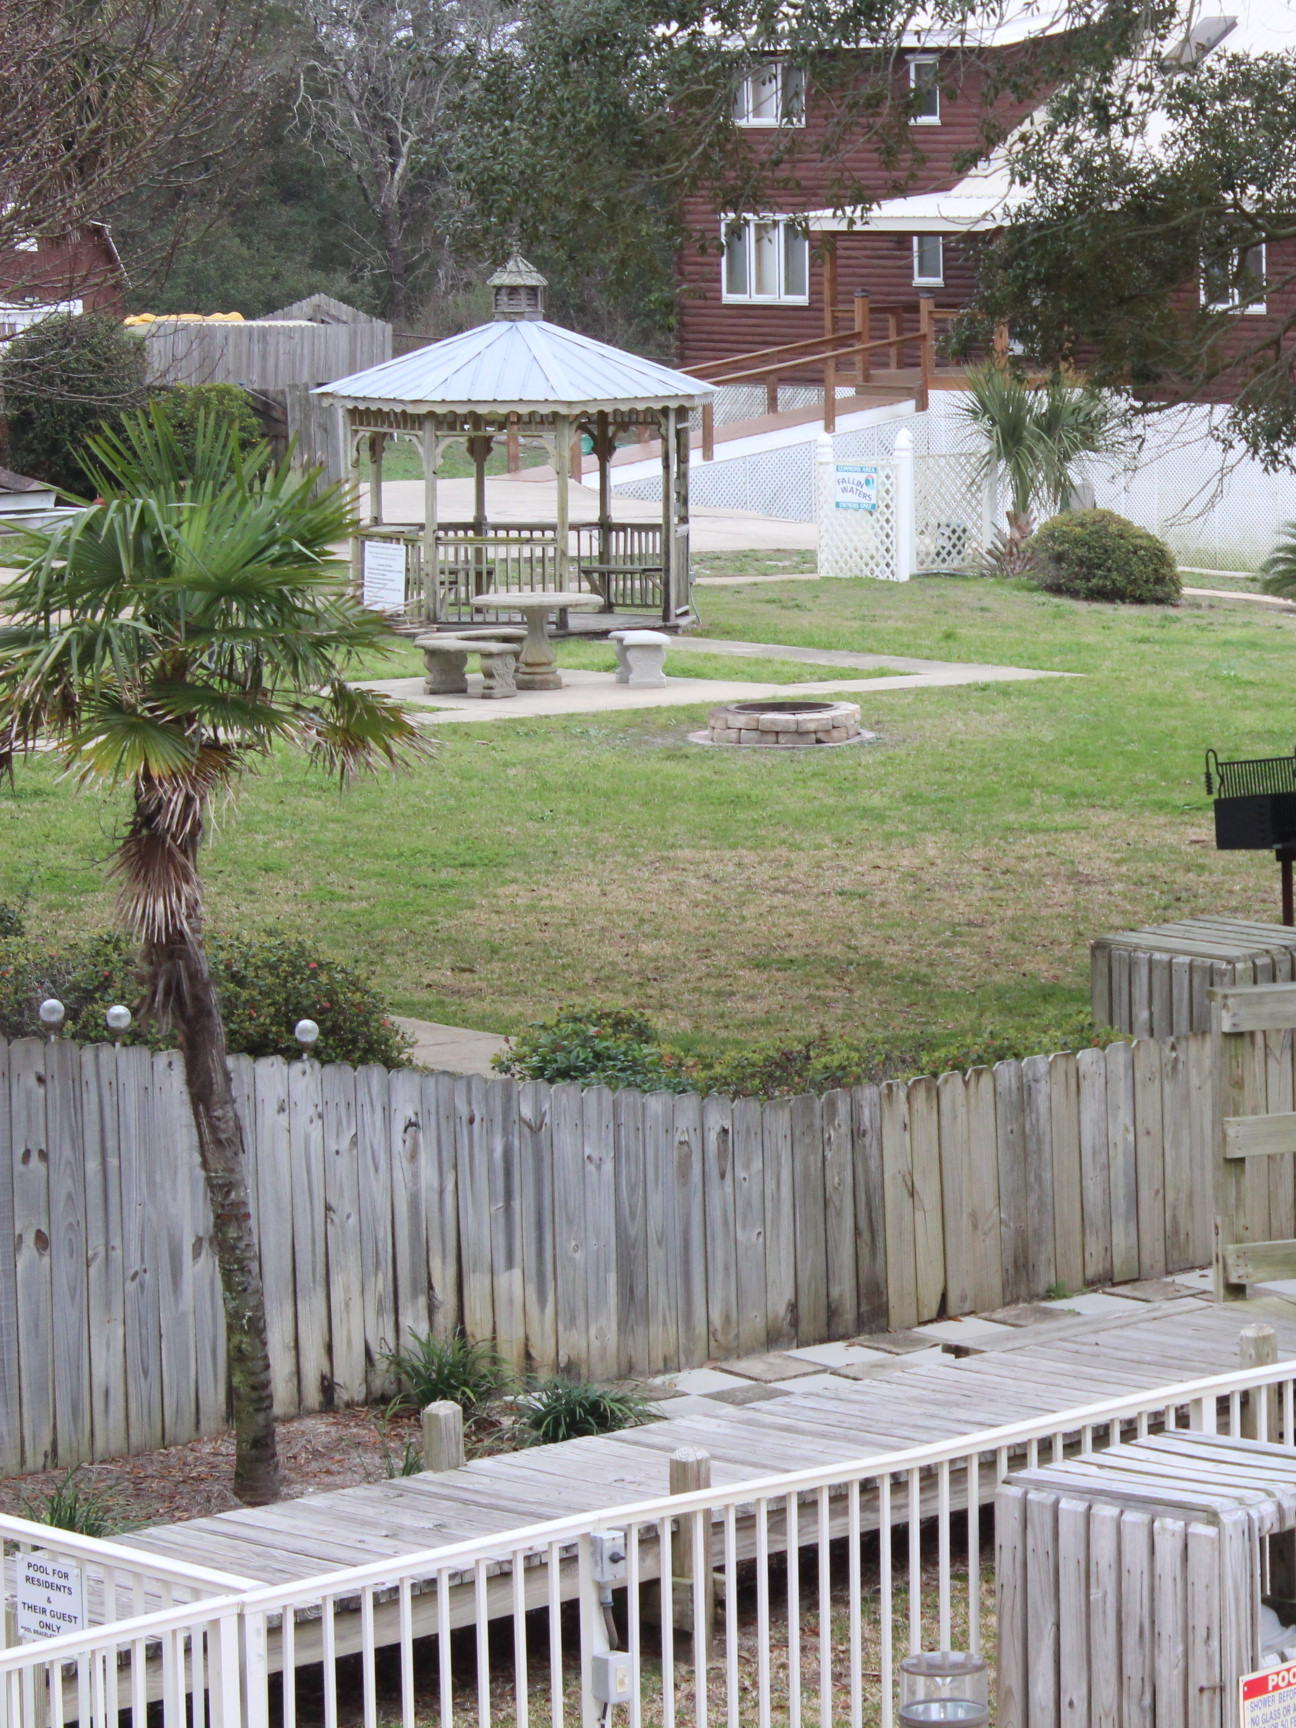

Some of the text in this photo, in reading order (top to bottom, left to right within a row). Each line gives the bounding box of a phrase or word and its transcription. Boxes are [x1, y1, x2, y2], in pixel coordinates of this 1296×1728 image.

[841, 486, 872, 501] WATERS
[27, 1562, 69, 1581] POOL FOR
[25, 1575, 73, 1595] RESIDENTS
[47, 1595, 52, 1604] &
[21, 1601, 78, 1624] THEIR GUEST
[39, 1620, 61, 1633] ONLY
[1250, 1695, 1275, 1712] SHOWER
[1250, 1715, 1260, 1726] NO
[1261, 1708, 1281, 1724] GLASS
[1283, 1705, 1291, 1717] OR
